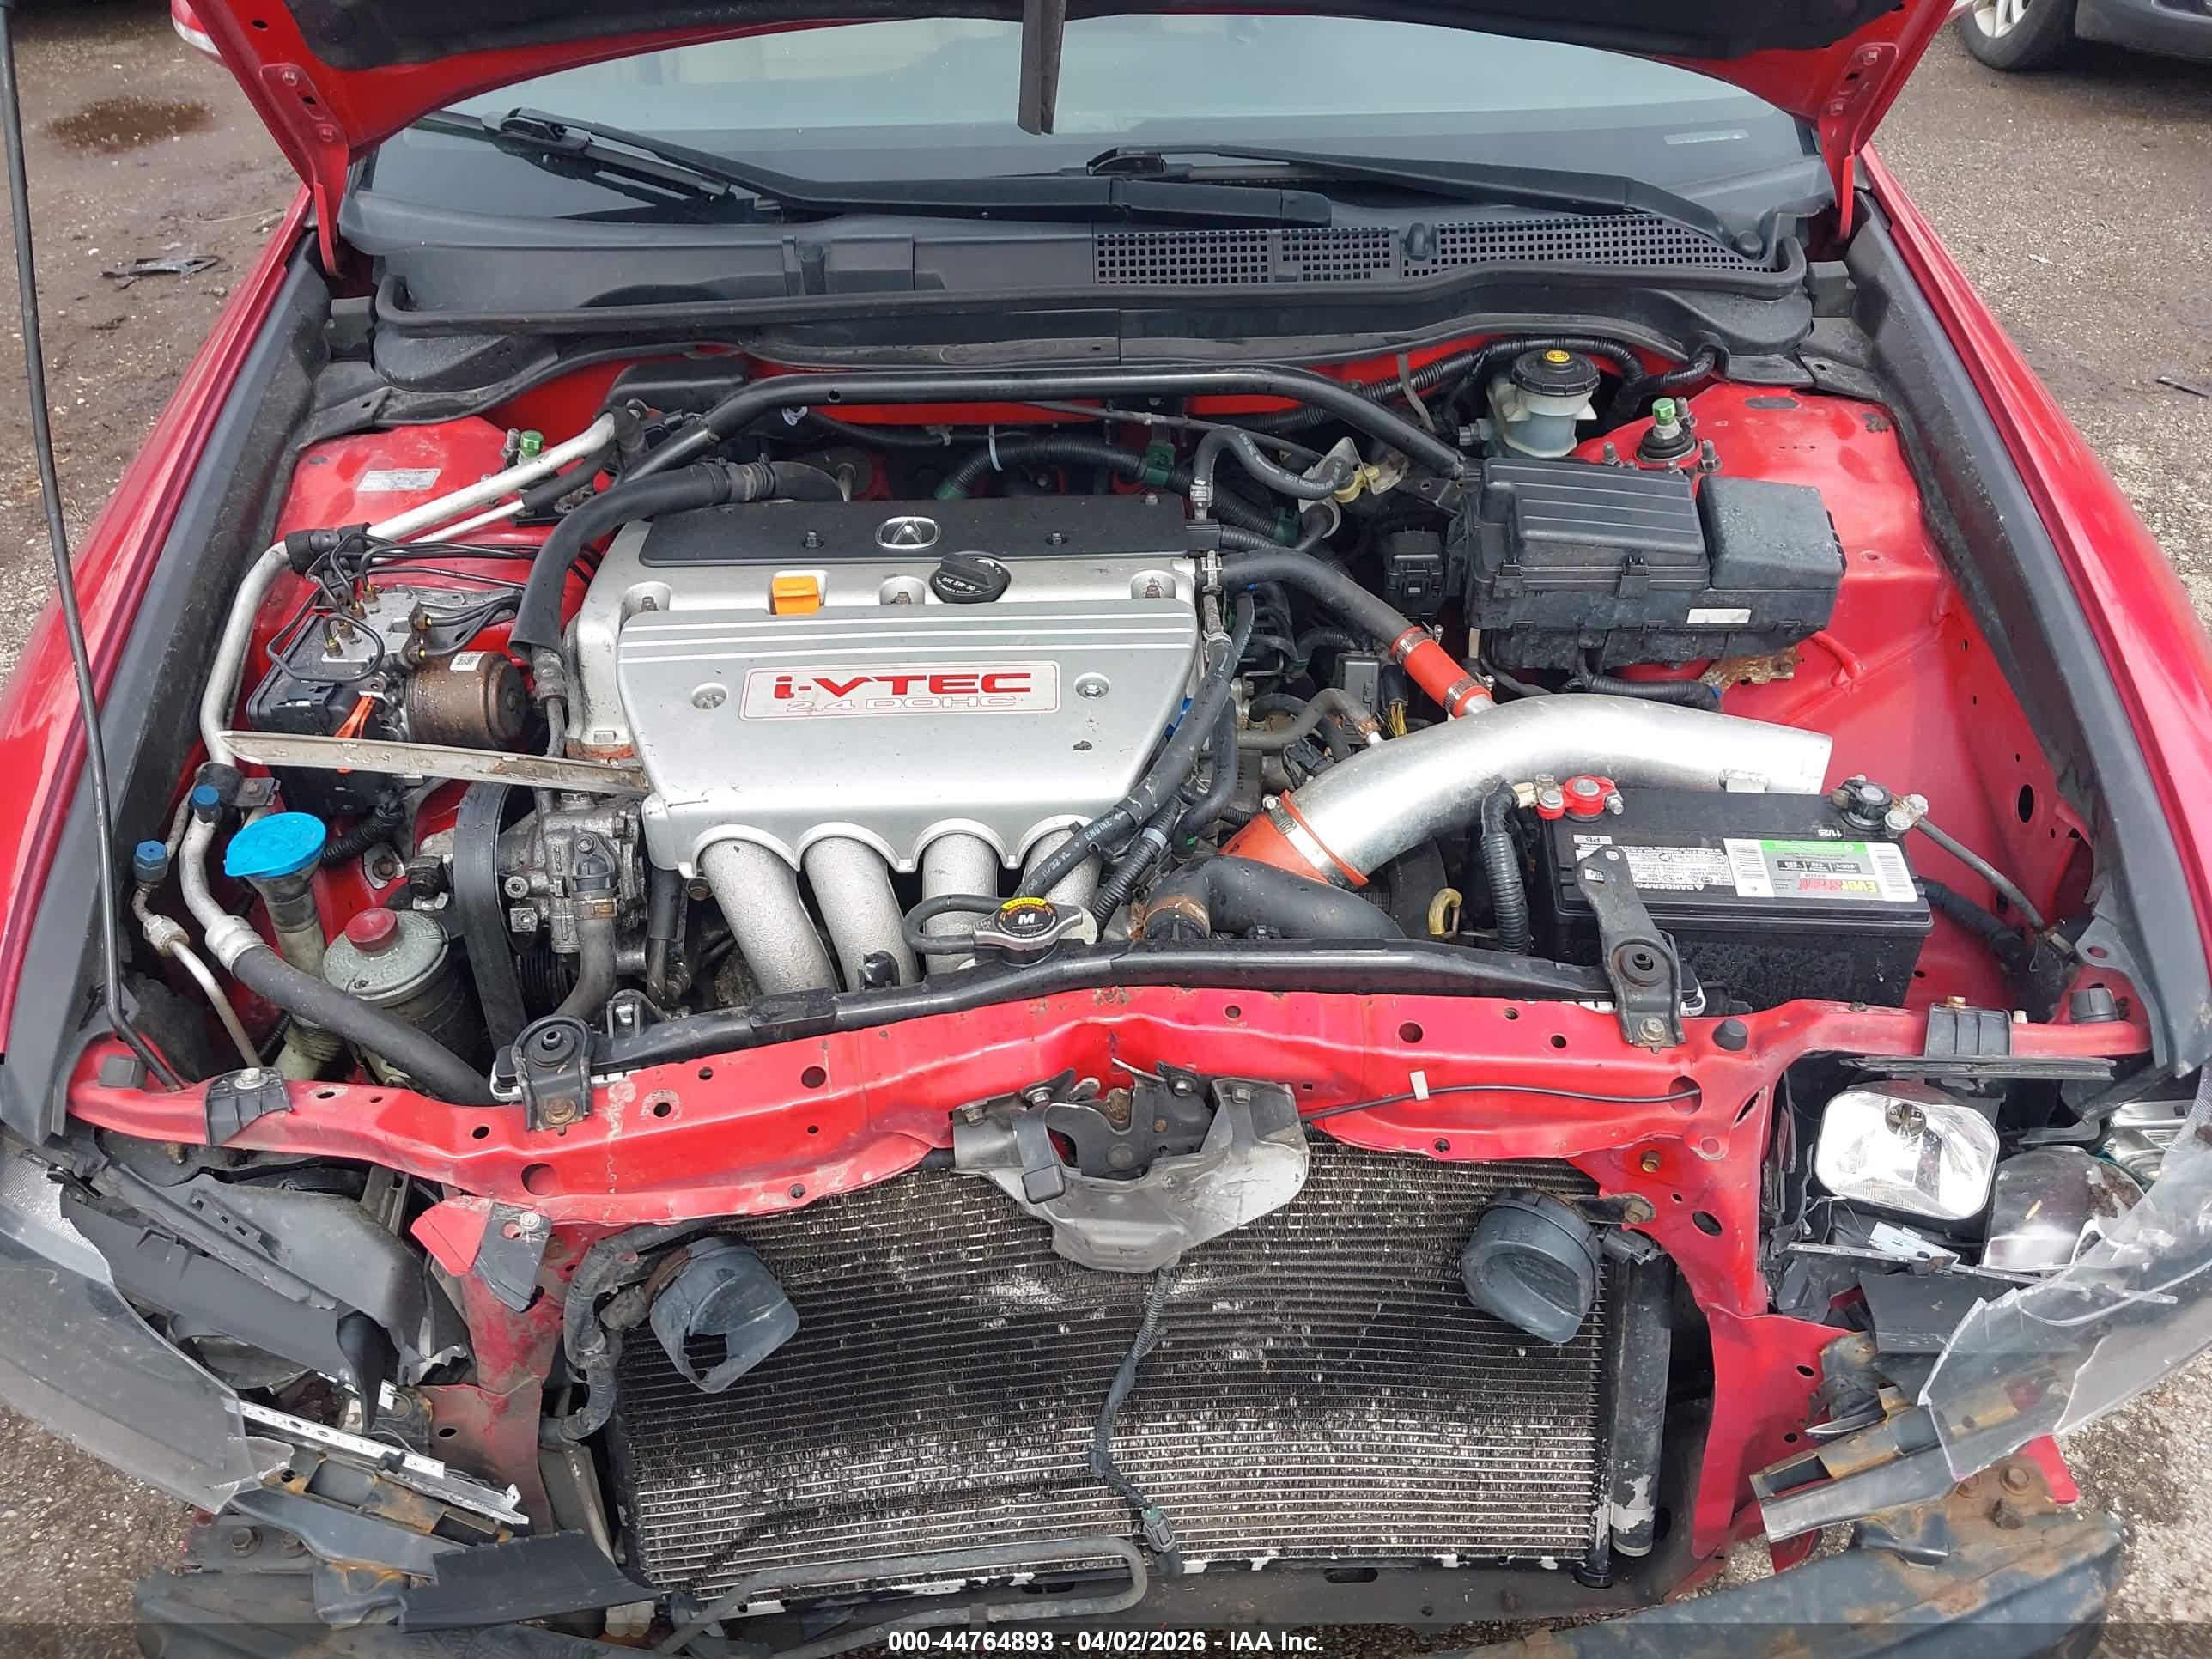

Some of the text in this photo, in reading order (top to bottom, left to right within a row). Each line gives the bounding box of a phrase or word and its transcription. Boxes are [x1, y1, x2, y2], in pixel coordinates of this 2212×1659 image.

[773, 672, 1031, 699] i-VTEC
[786, 695, 1018, 714] 2.4 DOHC
[1084, 818, 1113, 841] ENGINE
[1799, 878, 1878, 895] EverStart
[1018, 912, 1036, 925] M
